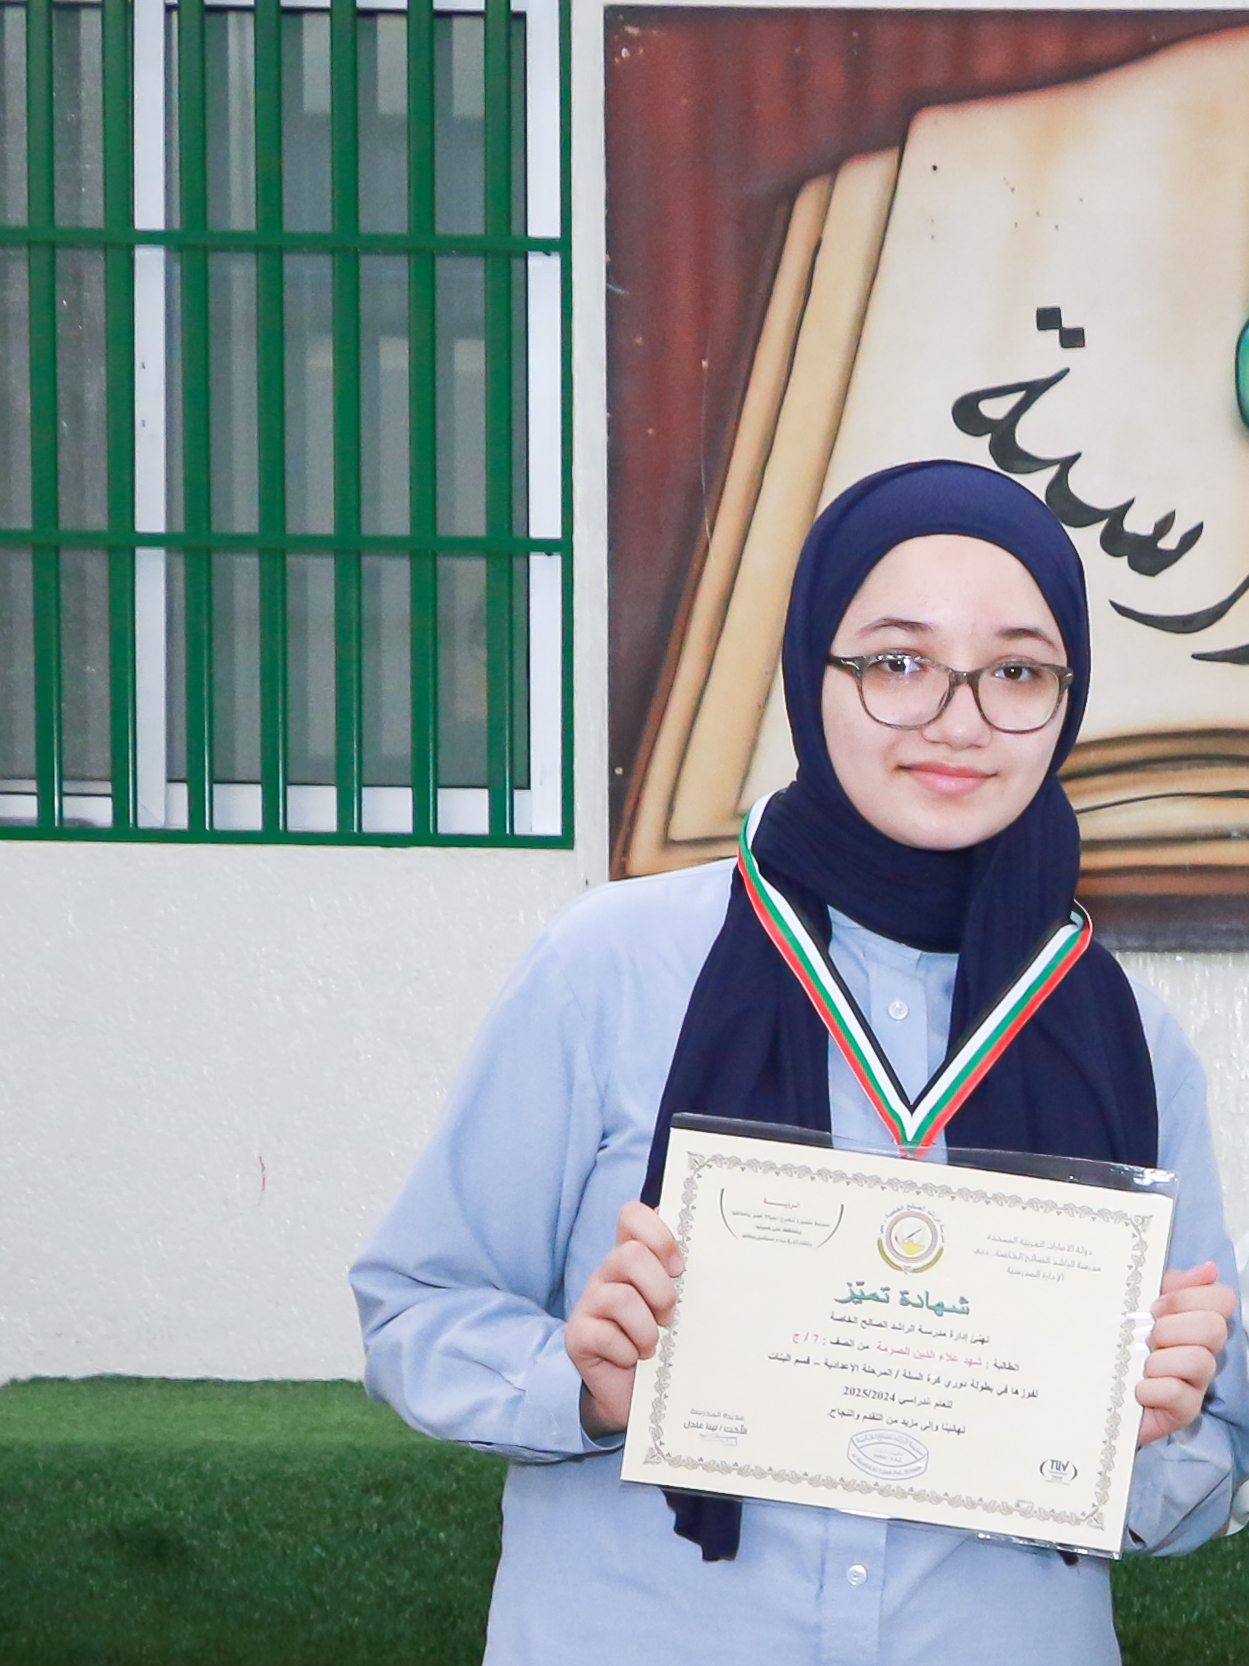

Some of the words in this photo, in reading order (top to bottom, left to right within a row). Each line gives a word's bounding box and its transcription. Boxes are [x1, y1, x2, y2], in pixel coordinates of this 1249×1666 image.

[898, 1290, 970, 1317] شهادة
[829, 1311, 858, 1323] الخاصة
[860, 1317, 888, 1329] الصالح
[890, 1322, 916, 1334] الراشد
[918, 1325, 947, 1338] مدرسة
[829, 1336, 855, 1347] الصف
[857, 1342, 870, 1351] من
[767, 1352, 791, 1363] البنات
[913, 1349, 936, 1359] الدين
[794, 1356, 810, 1366] قسم
[963, 1357, 982, 1367] شهد
[993, 1359, 1020, 1371] الطالبة
[862, 1362, 892, 1377] المرحلة
[902, 1368, 923, 1381] السلة
[926, 1374, 941, 1385] كرة
[944, 1380, 967, 1389] دوري
[970, 1379, 993, 1392] بطولة
[996, 1384, 1008, 1396] في
[843, 1386, 896, 1402] 2025/2024
[898, 1396, 931, 1406] الدراسي
[862, 1412, 884, 1422] التقدم
[885, 1416, 898, 1425] من
[901, 1418, 918, 1429] مزيد
